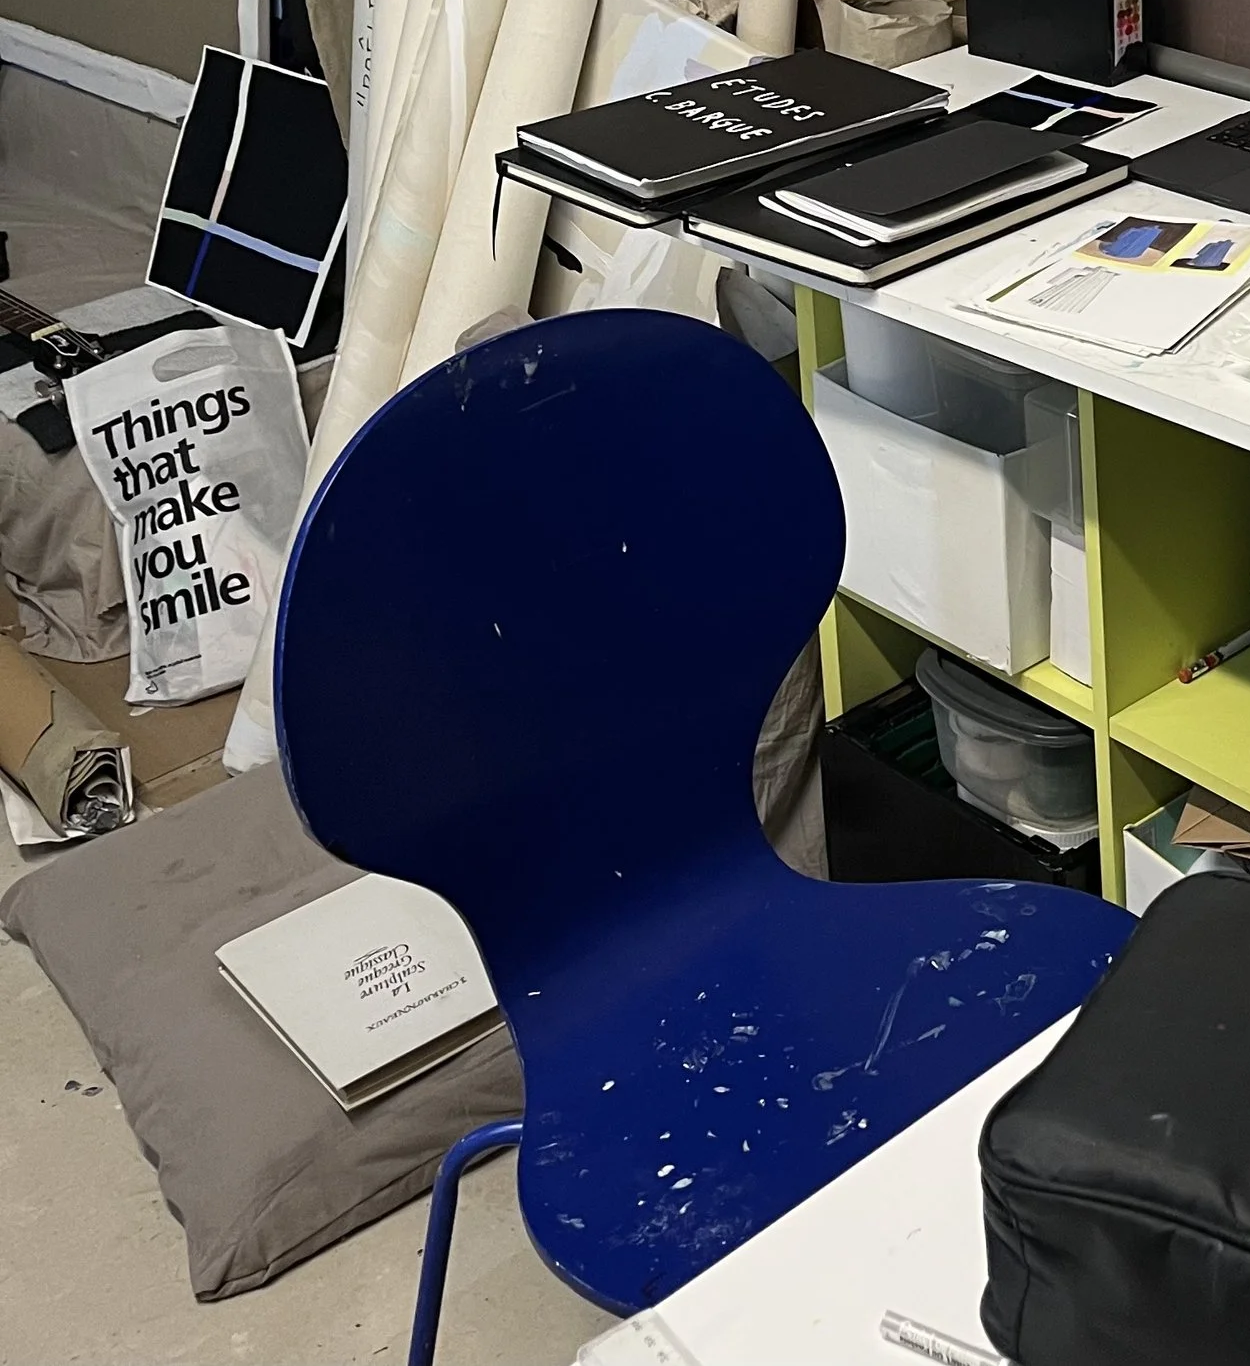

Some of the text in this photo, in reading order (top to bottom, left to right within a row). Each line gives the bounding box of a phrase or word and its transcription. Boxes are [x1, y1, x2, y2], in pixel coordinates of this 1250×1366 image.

[664, 100, 773, 140] BARGUE
[92, 386, 250, 460] Things
[113, 438, 200, 502] that
[133, 479, 240, 545] make
[134, 533, 206, 600] you
[140, 567, 251, 635] smile
[344, 943, 409, 981] Classique
[358, 955, 413, 987] Grecque
[360, 961, 426, 1000] Sculpture
[392, 981, 411, 997] La
